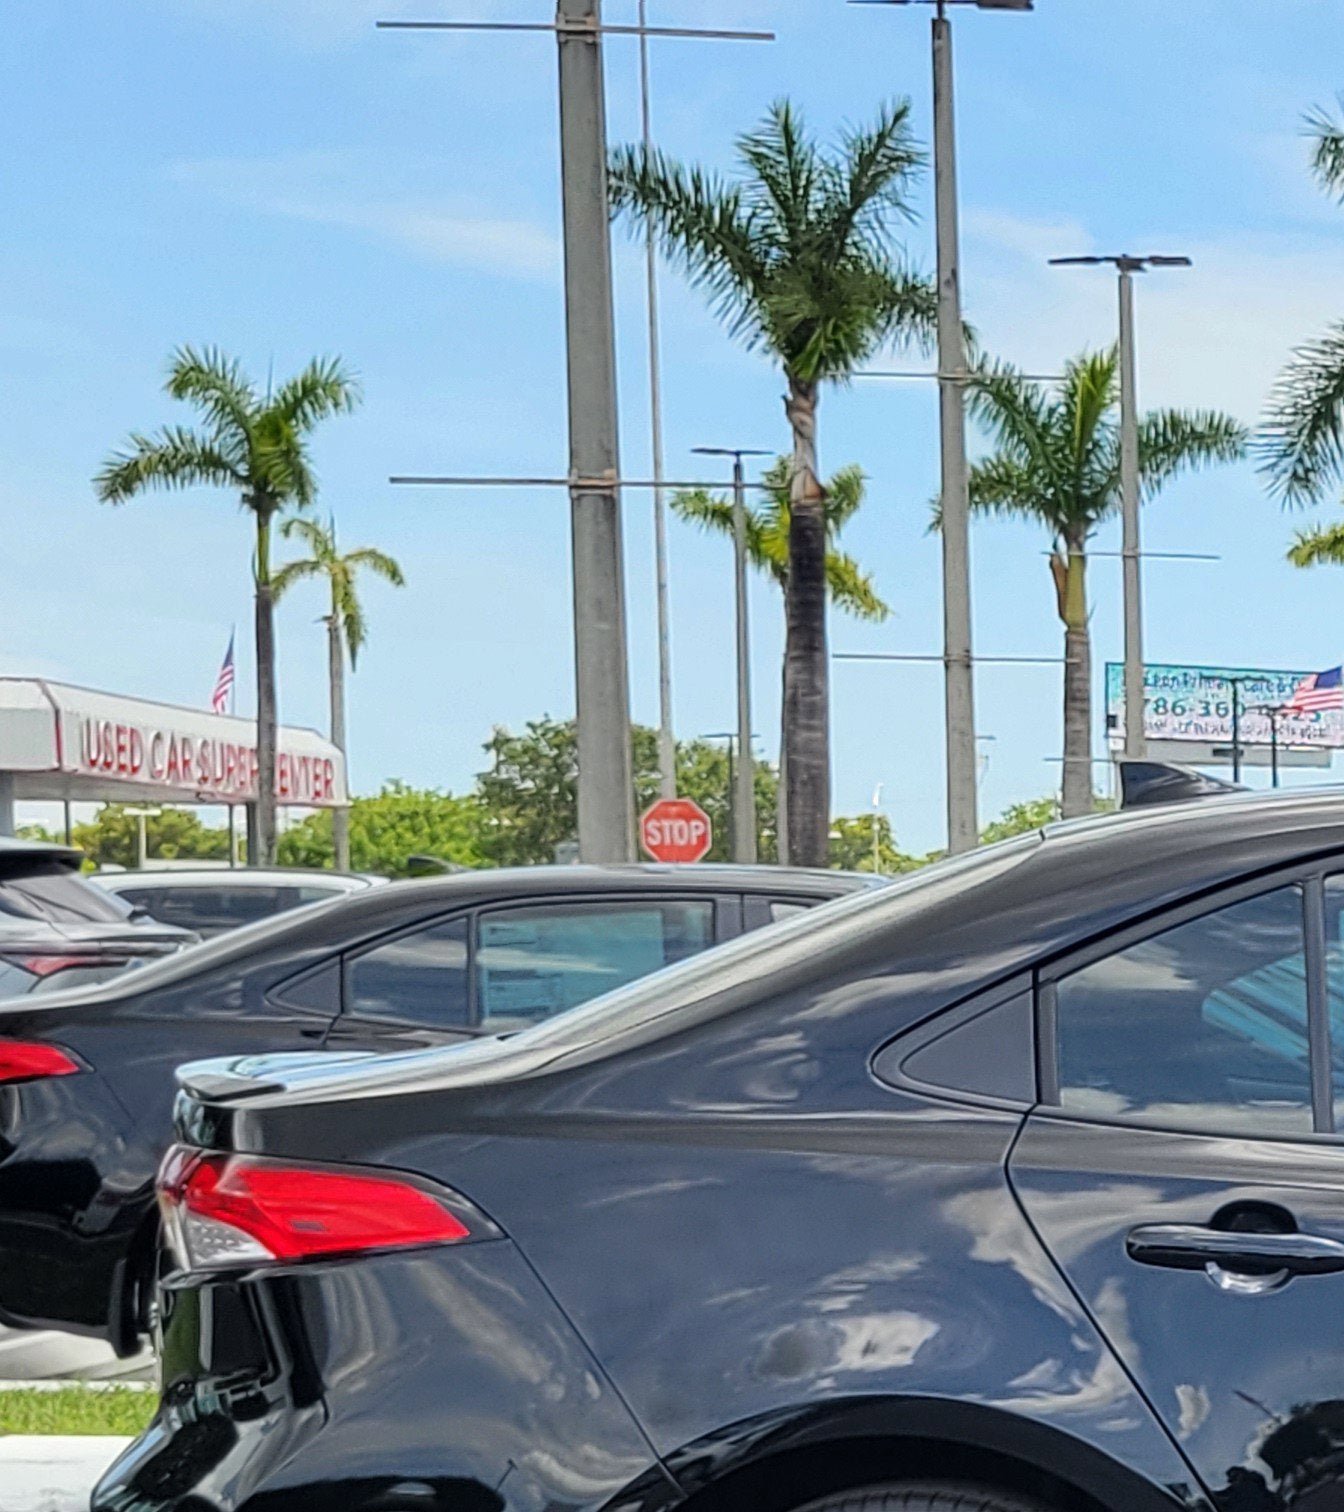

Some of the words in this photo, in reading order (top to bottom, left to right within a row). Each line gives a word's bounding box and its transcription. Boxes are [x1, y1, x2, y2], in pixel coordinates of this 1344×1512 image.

[82, 718, 143, 776] USED
[149, 730, 194, 783] CAR
[274, 752, 335, 800] ENTER
[646, 818, 705, 847] STOP
